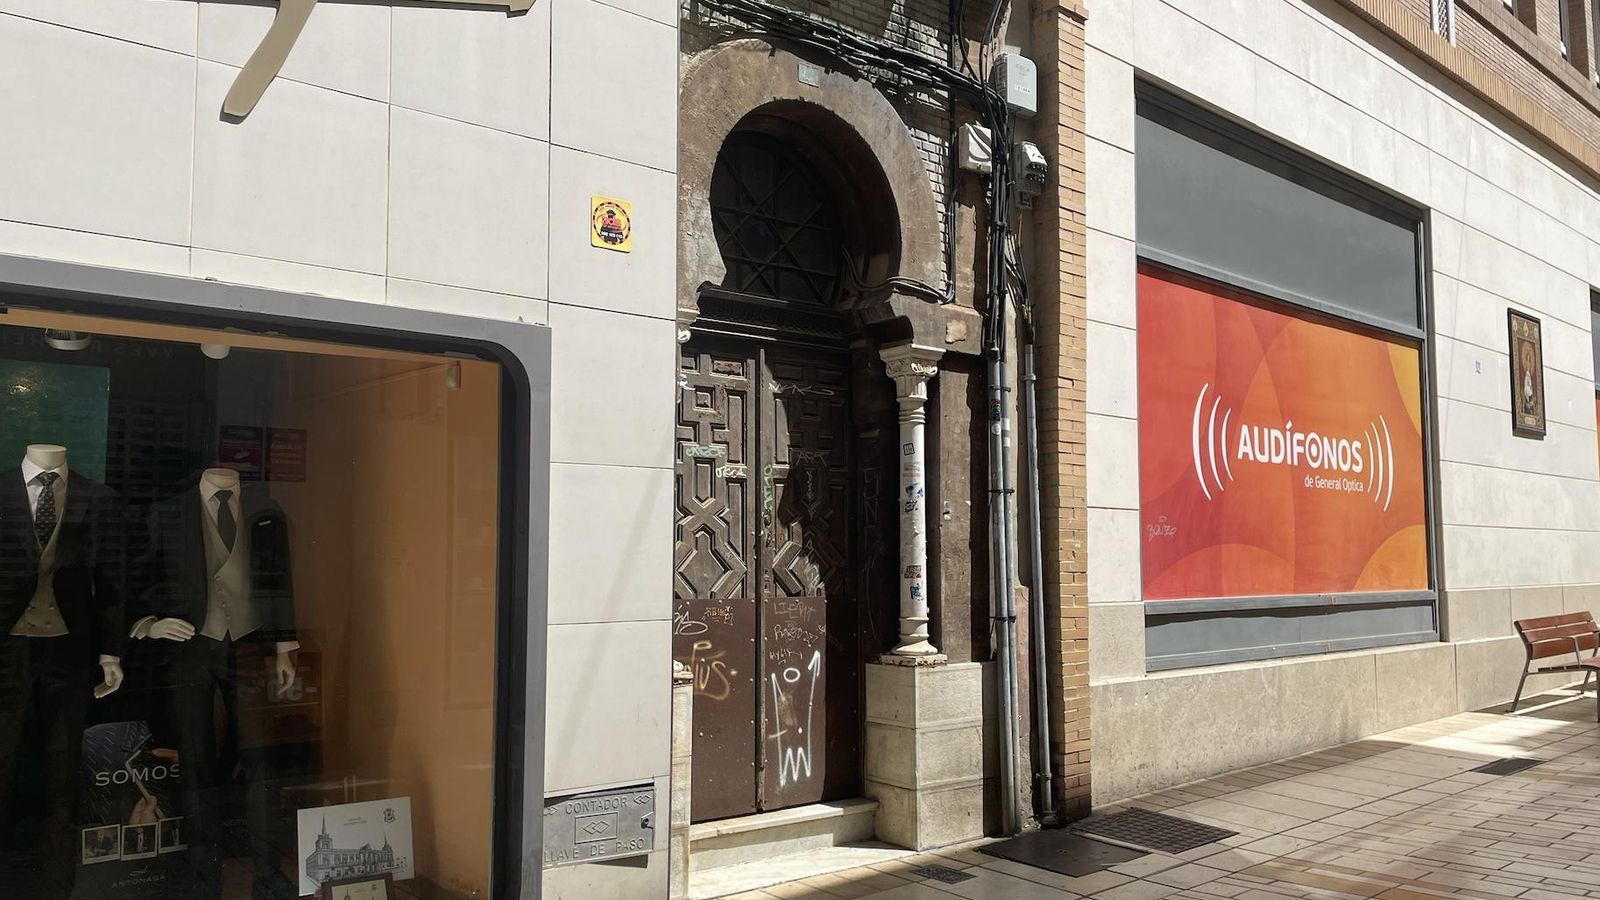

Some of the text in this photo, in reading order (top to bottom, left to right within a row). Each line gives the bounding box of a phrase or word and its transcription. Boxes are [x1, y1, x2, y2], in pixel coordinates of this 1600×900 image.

[1237, 420, 1364, 473] AUDÍFONOS
[1304, 474, 1364, 493] de General Optica
[95, 763, 181, 787] SOMOS
[565, 797, 628, 815] CONTADOR
[544, 838, 645, 863] LLAVE DE PASO
